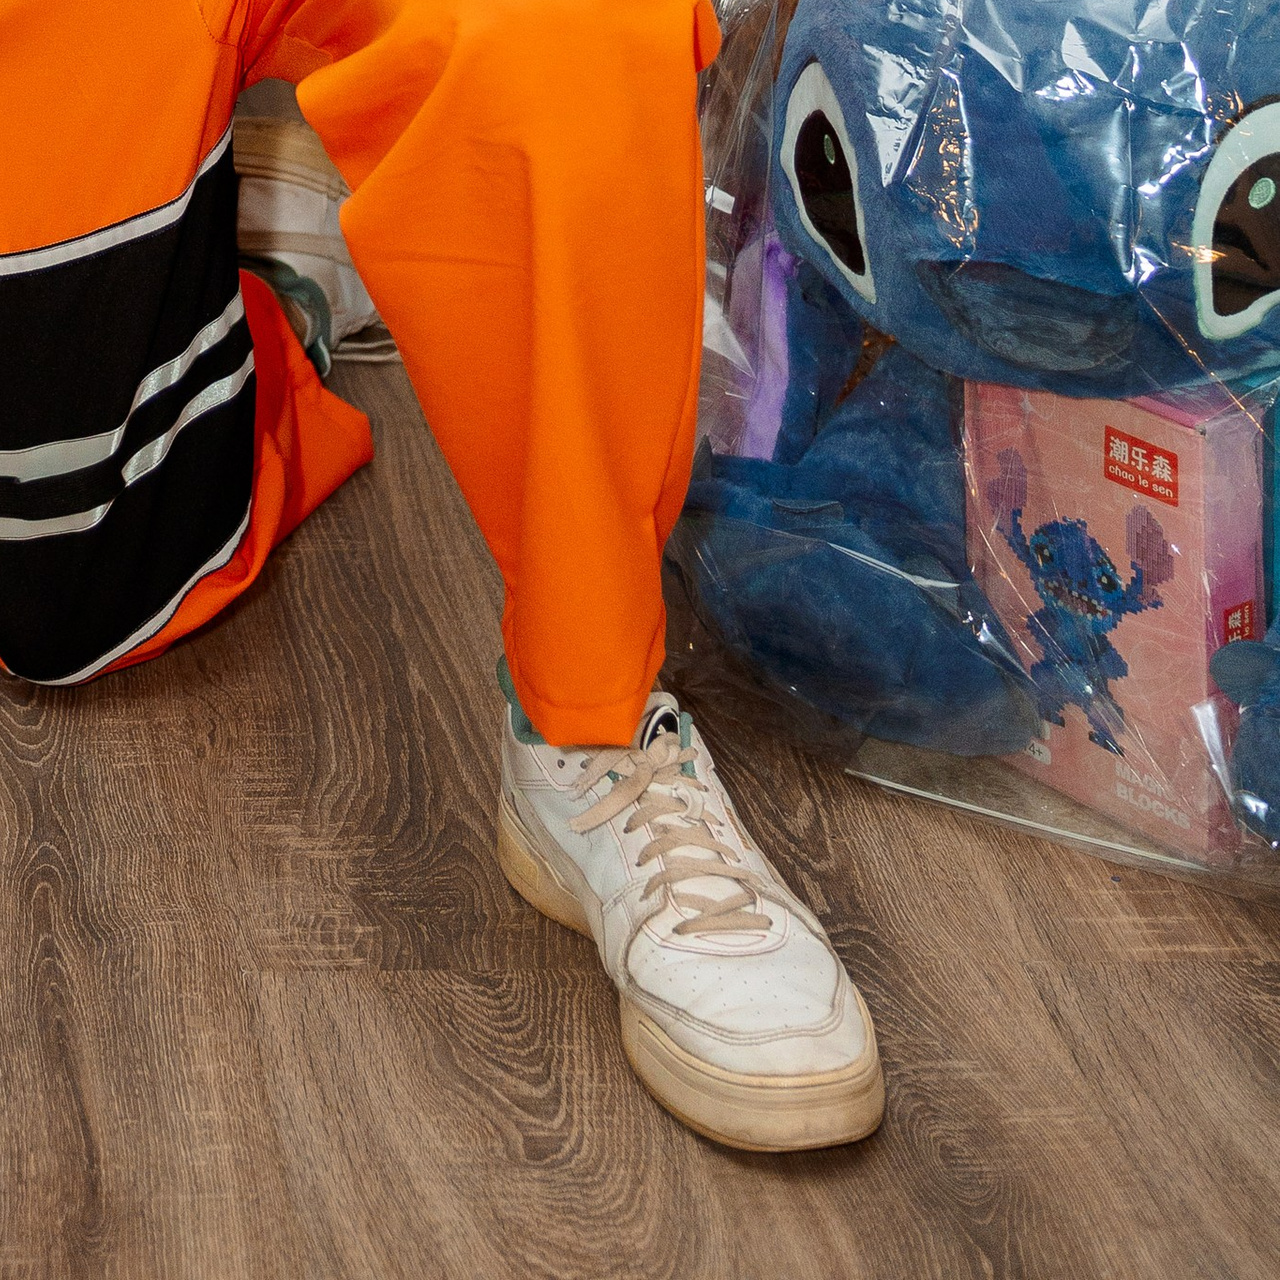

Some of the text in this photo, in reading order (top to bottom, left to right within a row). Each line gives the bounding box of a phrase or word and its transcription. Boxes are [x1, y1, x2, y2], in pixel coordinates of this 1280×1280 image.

[1109, 435, 1173, 482] 潮乐森
[1109, 465, 1173, 498] chao le sen
[1116, 782, 1191, 830] BLOCKS
